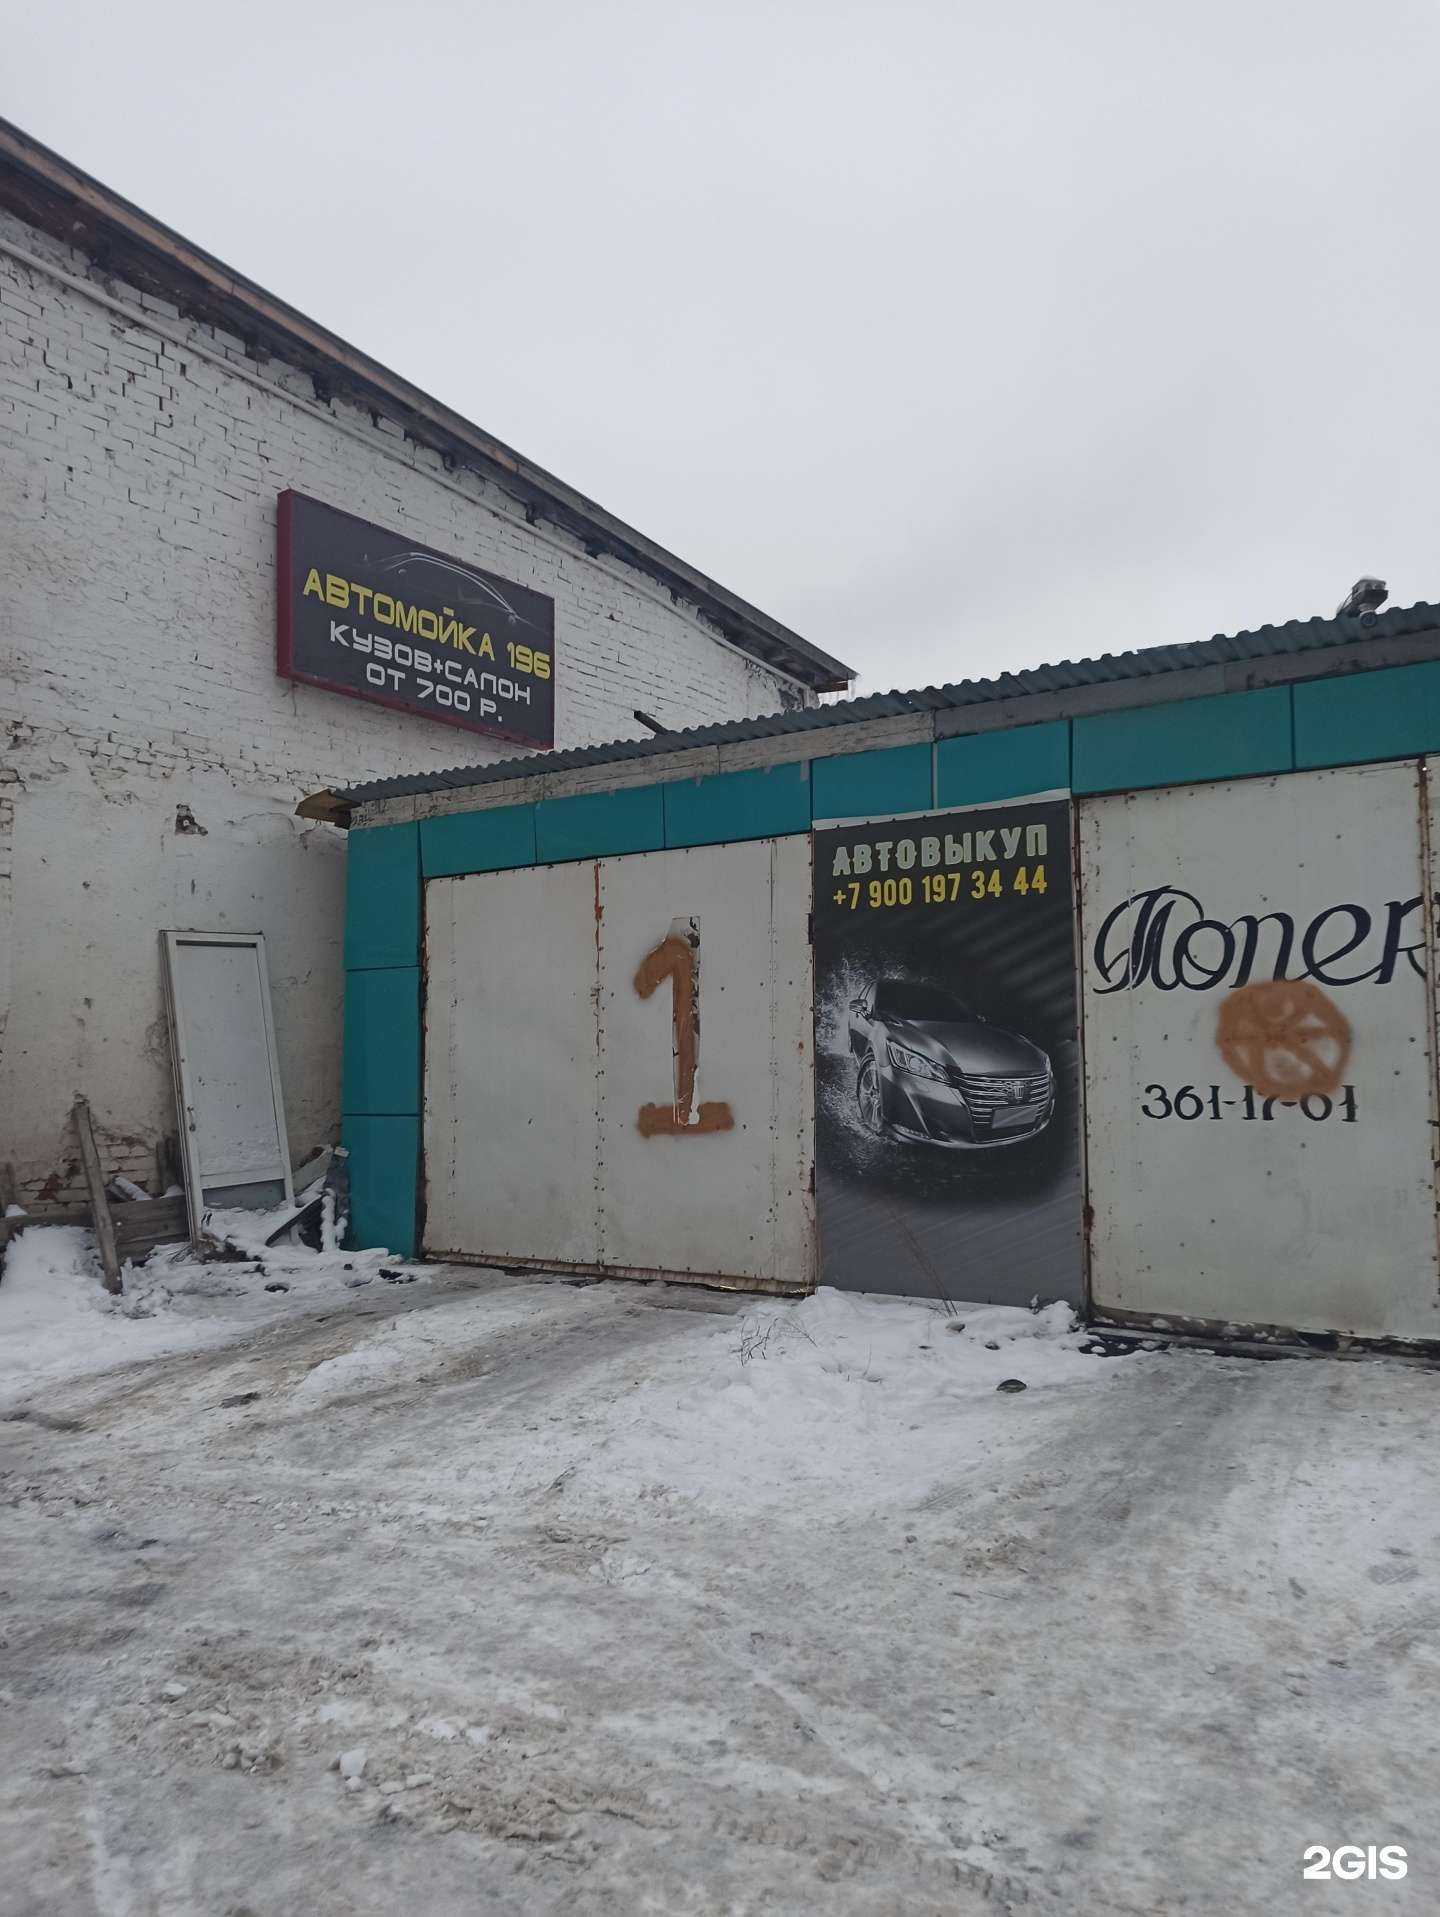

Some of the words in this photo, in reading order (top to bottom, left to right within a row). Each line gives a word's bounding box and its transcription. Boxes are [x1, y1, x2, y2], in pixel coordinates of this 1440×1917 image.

[303, 568, 495, 661] АВТОМОЙКА
[506, 641, 551, 680] 196
[366, 662, 405, 691] ОТ
[416, 678, 471, 713] 700
[832, 824, 1048, 876] АВТОВЫКУП
[833, 882, 860, 910] +7
[869, 877, 912, 908] 900
[922, 872, 961, 903] 197
[971, 869, 1002, 899] 34
[1013, 864, 1048, 895] 44
